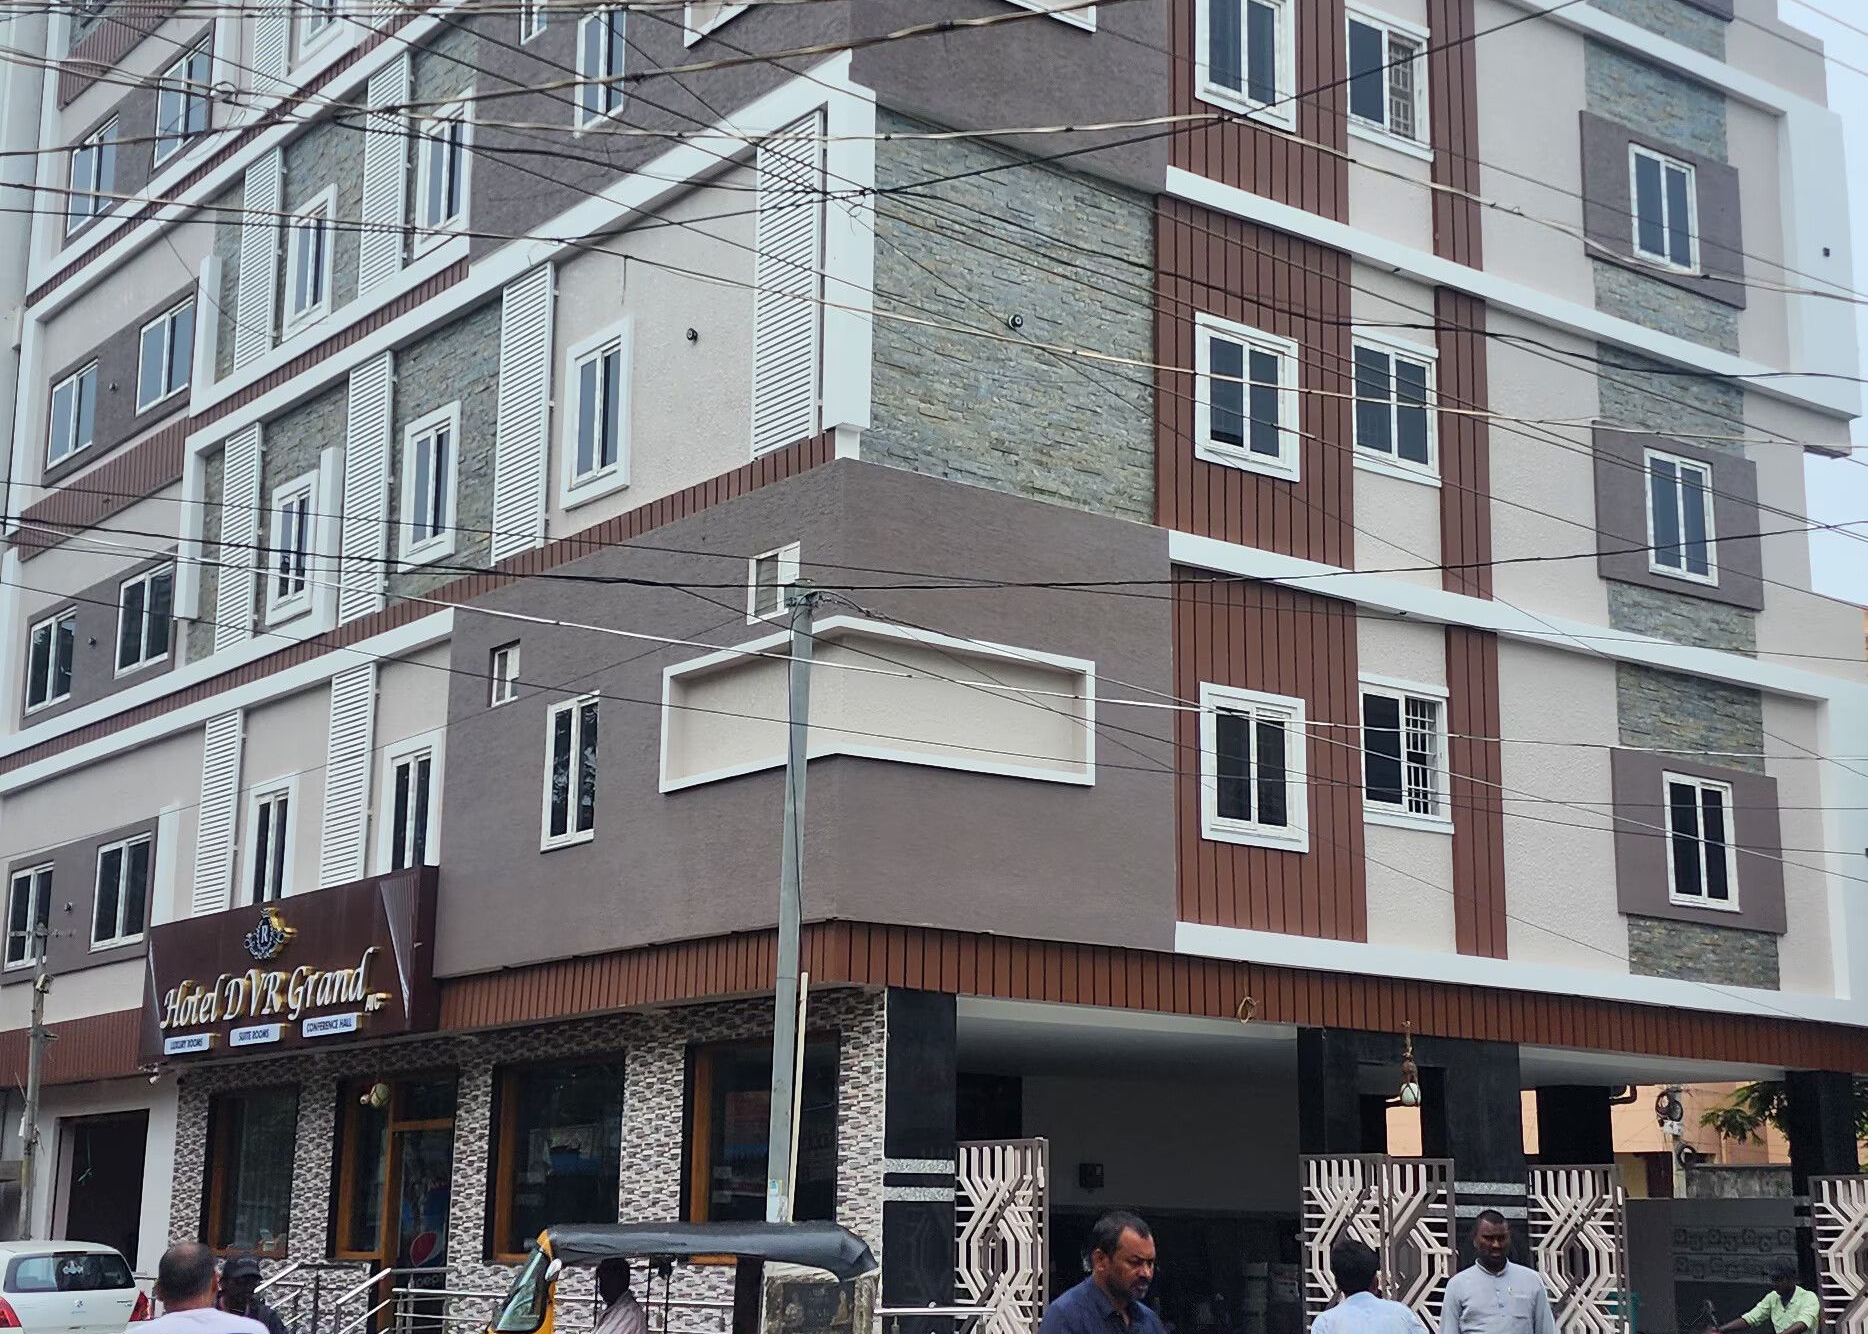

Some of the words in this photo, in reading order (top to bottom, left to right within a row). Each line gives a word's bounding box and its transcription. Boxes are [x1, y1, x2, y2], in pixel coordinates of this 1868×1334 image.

[159, 973, 230, 1029] Hotel
[222, 969, 284, 1021] DVR
[288, 946, 377, 1021] Grand
[252, 1028, 270, 1040] ROOMS
[306, 1018, 339, 1034] CONFERENCE
[340, 1017, 353, 1028] HALL
